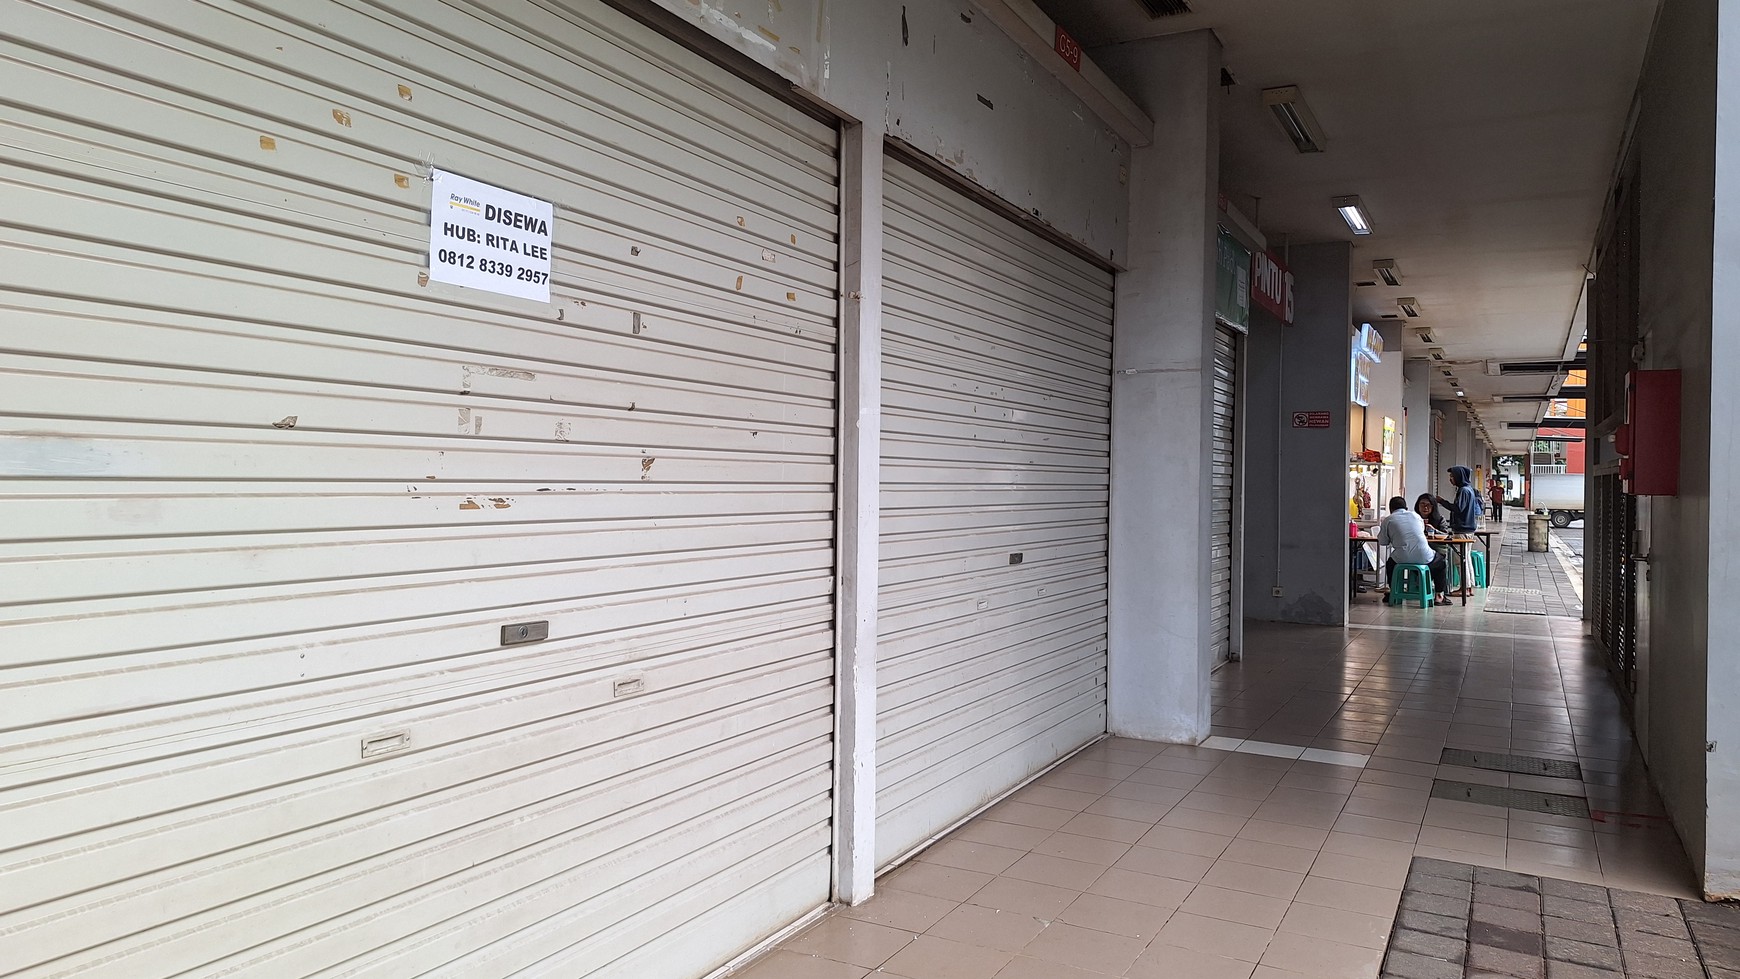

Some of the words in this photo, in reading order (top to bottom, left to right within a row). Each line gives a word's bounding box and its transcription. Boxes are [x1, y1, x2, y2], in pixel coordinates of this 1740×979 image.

[450, 193, 463, 203] Ray
[463, 197, 481, 207] White
[485, 204, 548, 236] DISEWA
[443, 222, 481, 244] HUB:
[486, 233, 519, 253] RITA
[523, 243, 548, 261] LEE
[438, 248, 475, 269] 0812
[479, 258, 513, 277] 8339
[517, 267, 549, 285] 2957
[1254, 251, 1283, 305] PINTU
[1284, 270, 1295, 324] 15
